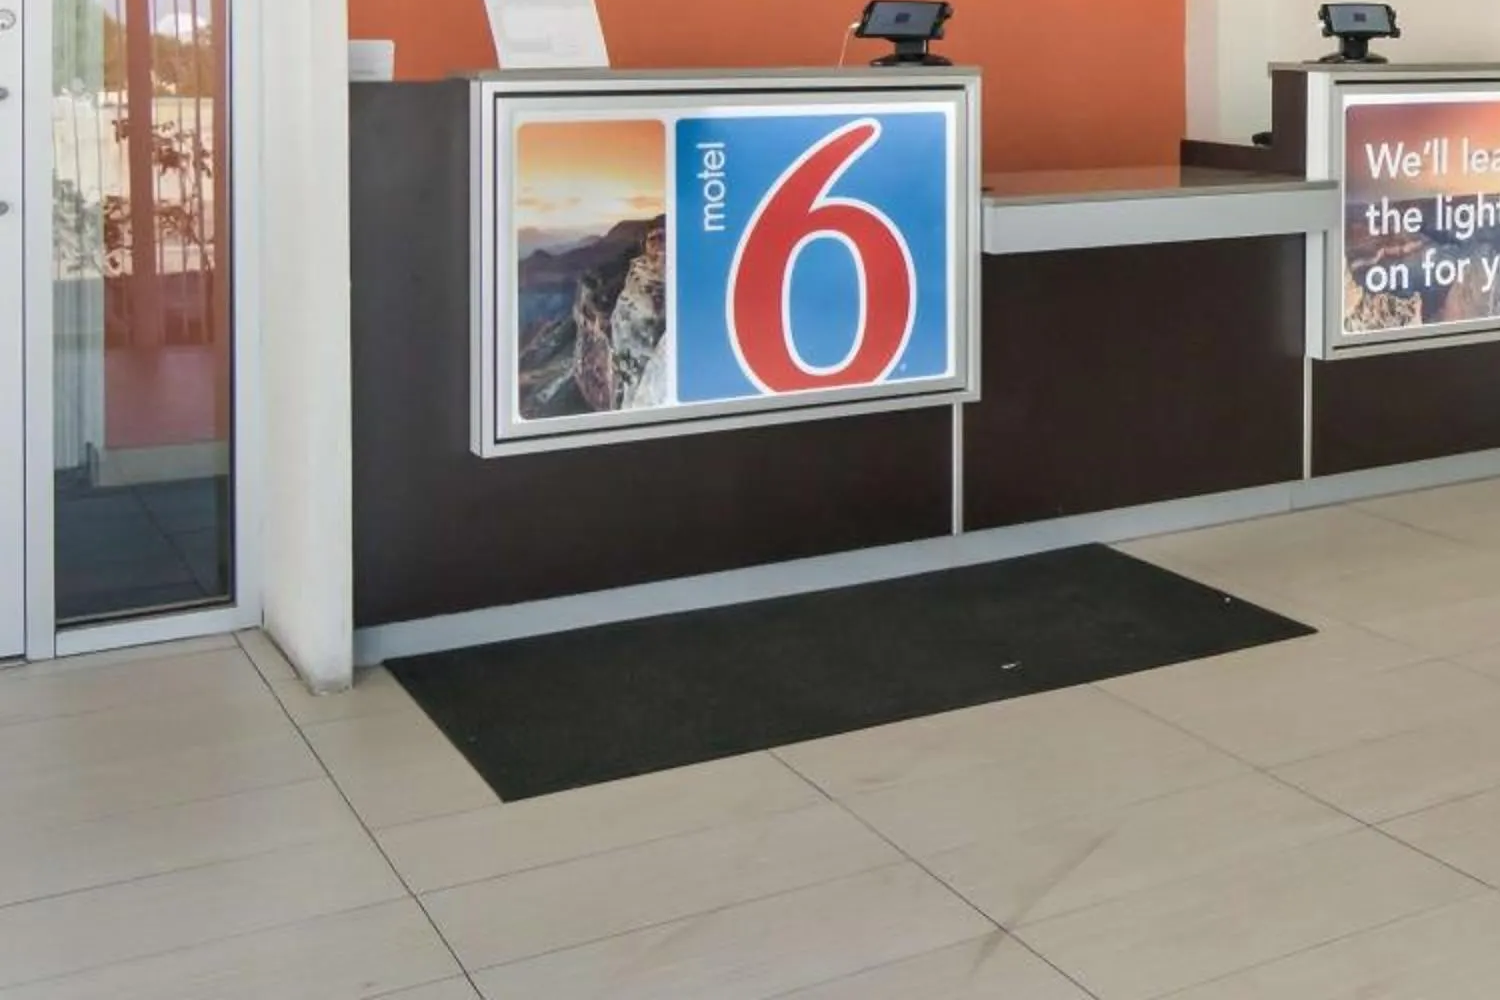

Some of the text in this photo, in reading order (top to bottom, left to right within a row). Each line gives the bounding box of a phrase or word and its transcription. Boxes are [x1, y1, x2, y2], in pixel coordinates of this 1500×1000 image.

[1365, 138, 1449, 180] We'll
[1365, 196, 1423, 236] the
[696, 117, 918, 395] motel 6
[1365, 262, 1409, 292] on
[1422, 249, 1471, 287] for
